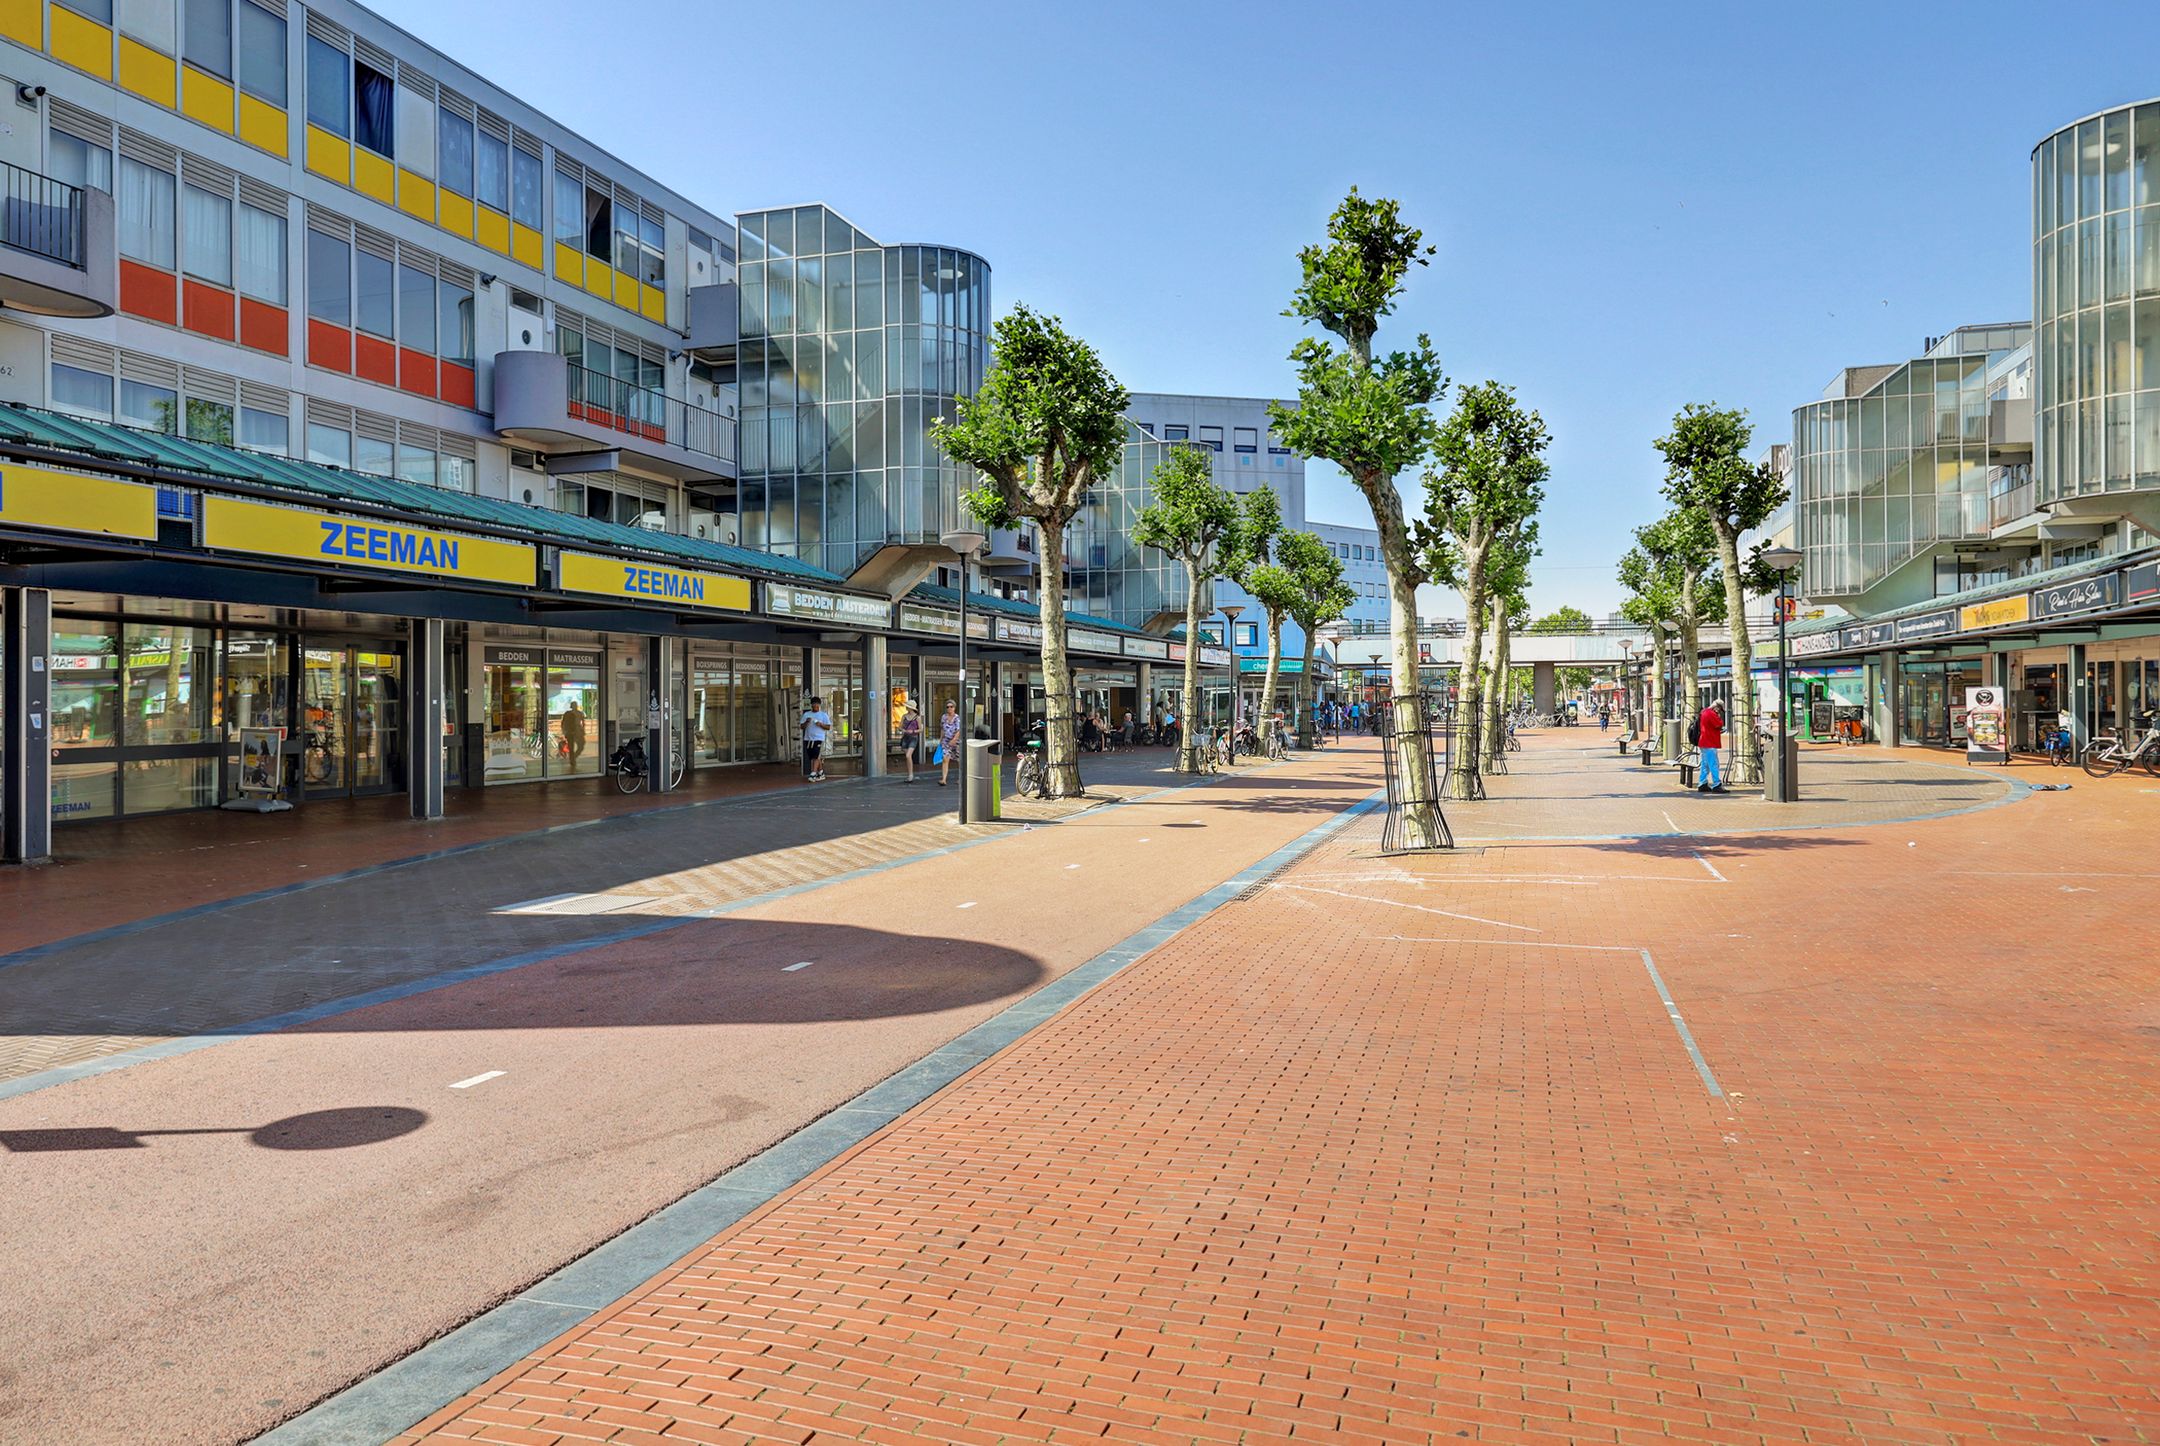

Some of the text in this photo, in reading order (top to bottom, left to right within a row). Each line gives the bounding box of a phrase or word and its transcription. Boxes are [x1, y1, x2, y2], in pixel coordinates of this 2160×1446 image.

[320, 520, 459, 570] ZEEMAN
[624, 566, 705, 601] ZEEMAN
[794, 592, 888, 618] BEDDEN AMSTERDAM
[498, 651, 529, 662] BEDDEN
[553, 654, 594, 664] MATRASSEN
[696, 661, 728, 669] BOXSPRINGS
[735, 663, 766, 671] BEDDENGOED
